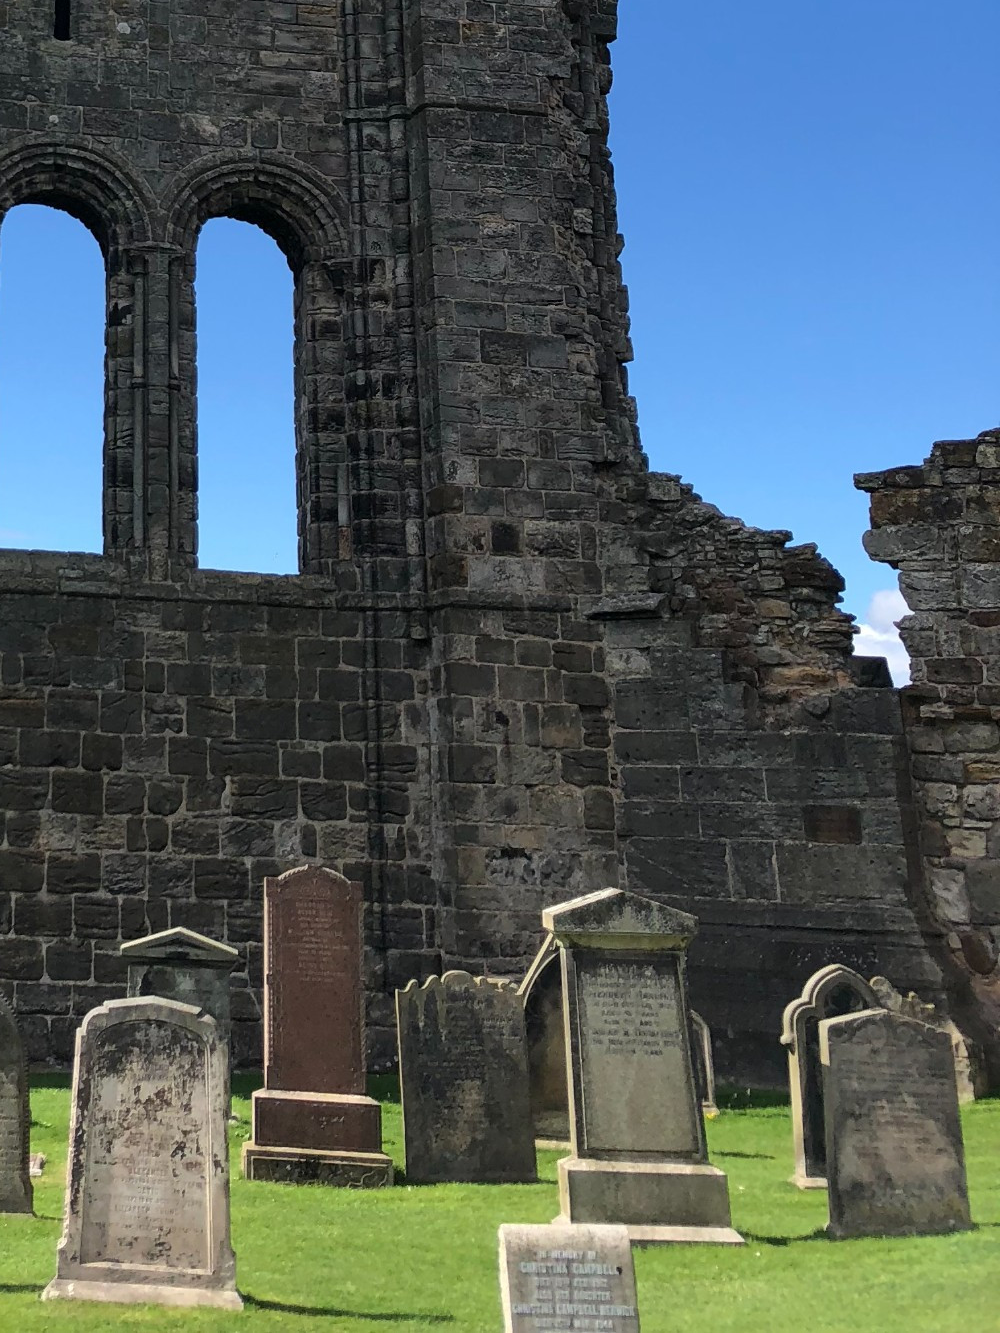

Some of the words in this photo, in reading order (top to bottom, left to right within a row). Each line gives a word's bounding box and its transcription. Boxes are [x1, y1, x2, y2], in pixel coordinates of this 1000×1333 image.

[550, 1250, 584, 1260] MEMORY
[519, 1262, 568, 1274] CHRISTINA
[572, 1263, 620, 1275] CAMPBELL
[573, 1291, 612, 1301] DAUGHTER
[513, 1303, 554, 1314] CHRISTINA
[556, 1304, 599, 1315] CAMPBELL
